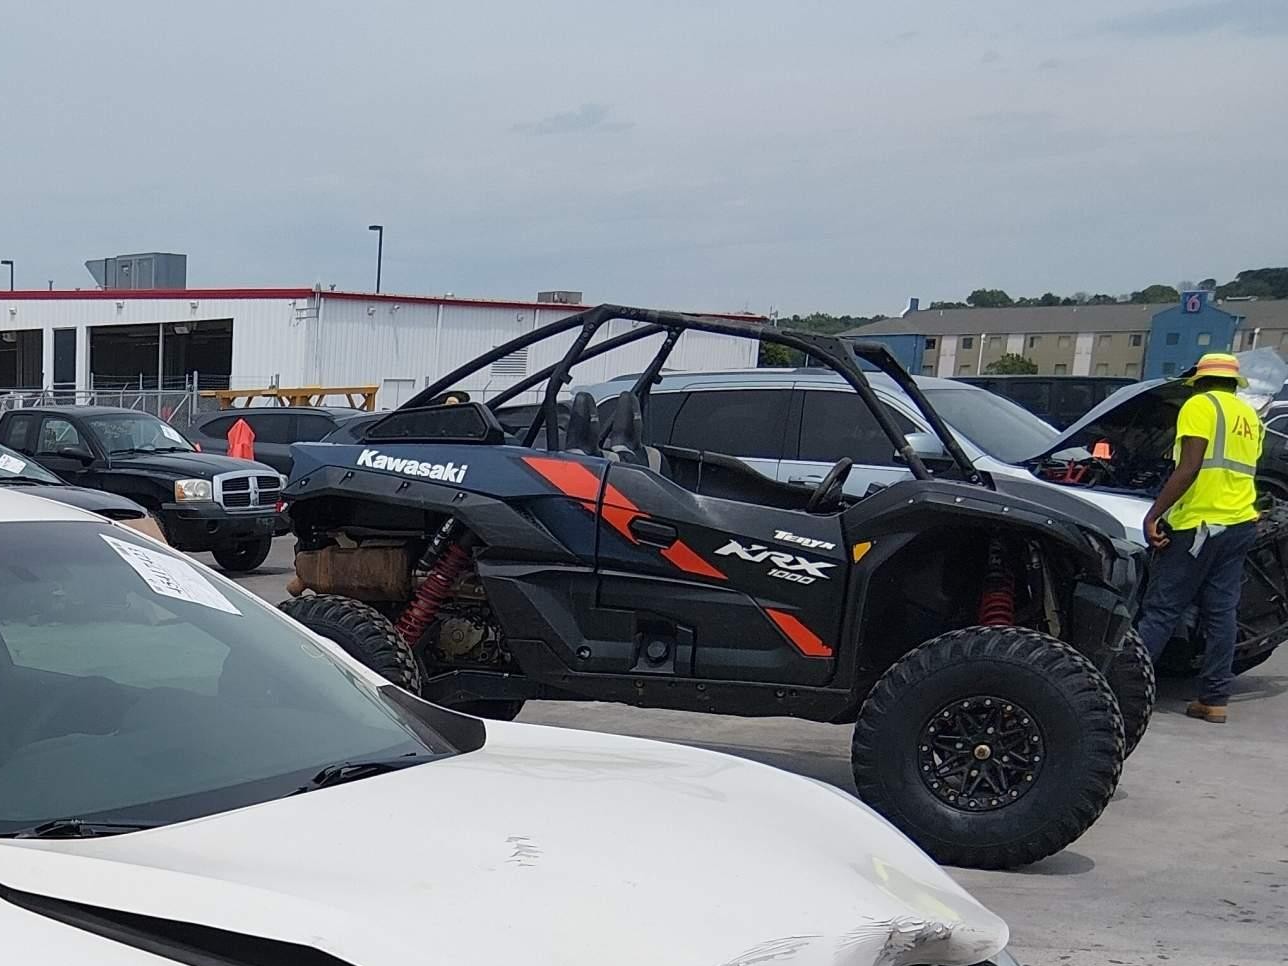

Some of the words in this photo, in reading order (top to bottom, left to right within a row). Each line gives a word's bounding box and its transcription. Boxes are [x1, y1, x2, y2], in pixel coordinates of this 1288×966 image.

[356, 449, 468, 484] Kawasaki
[713, 539, 839, 580] KRX
[767, 568, 817, 585] 1000
